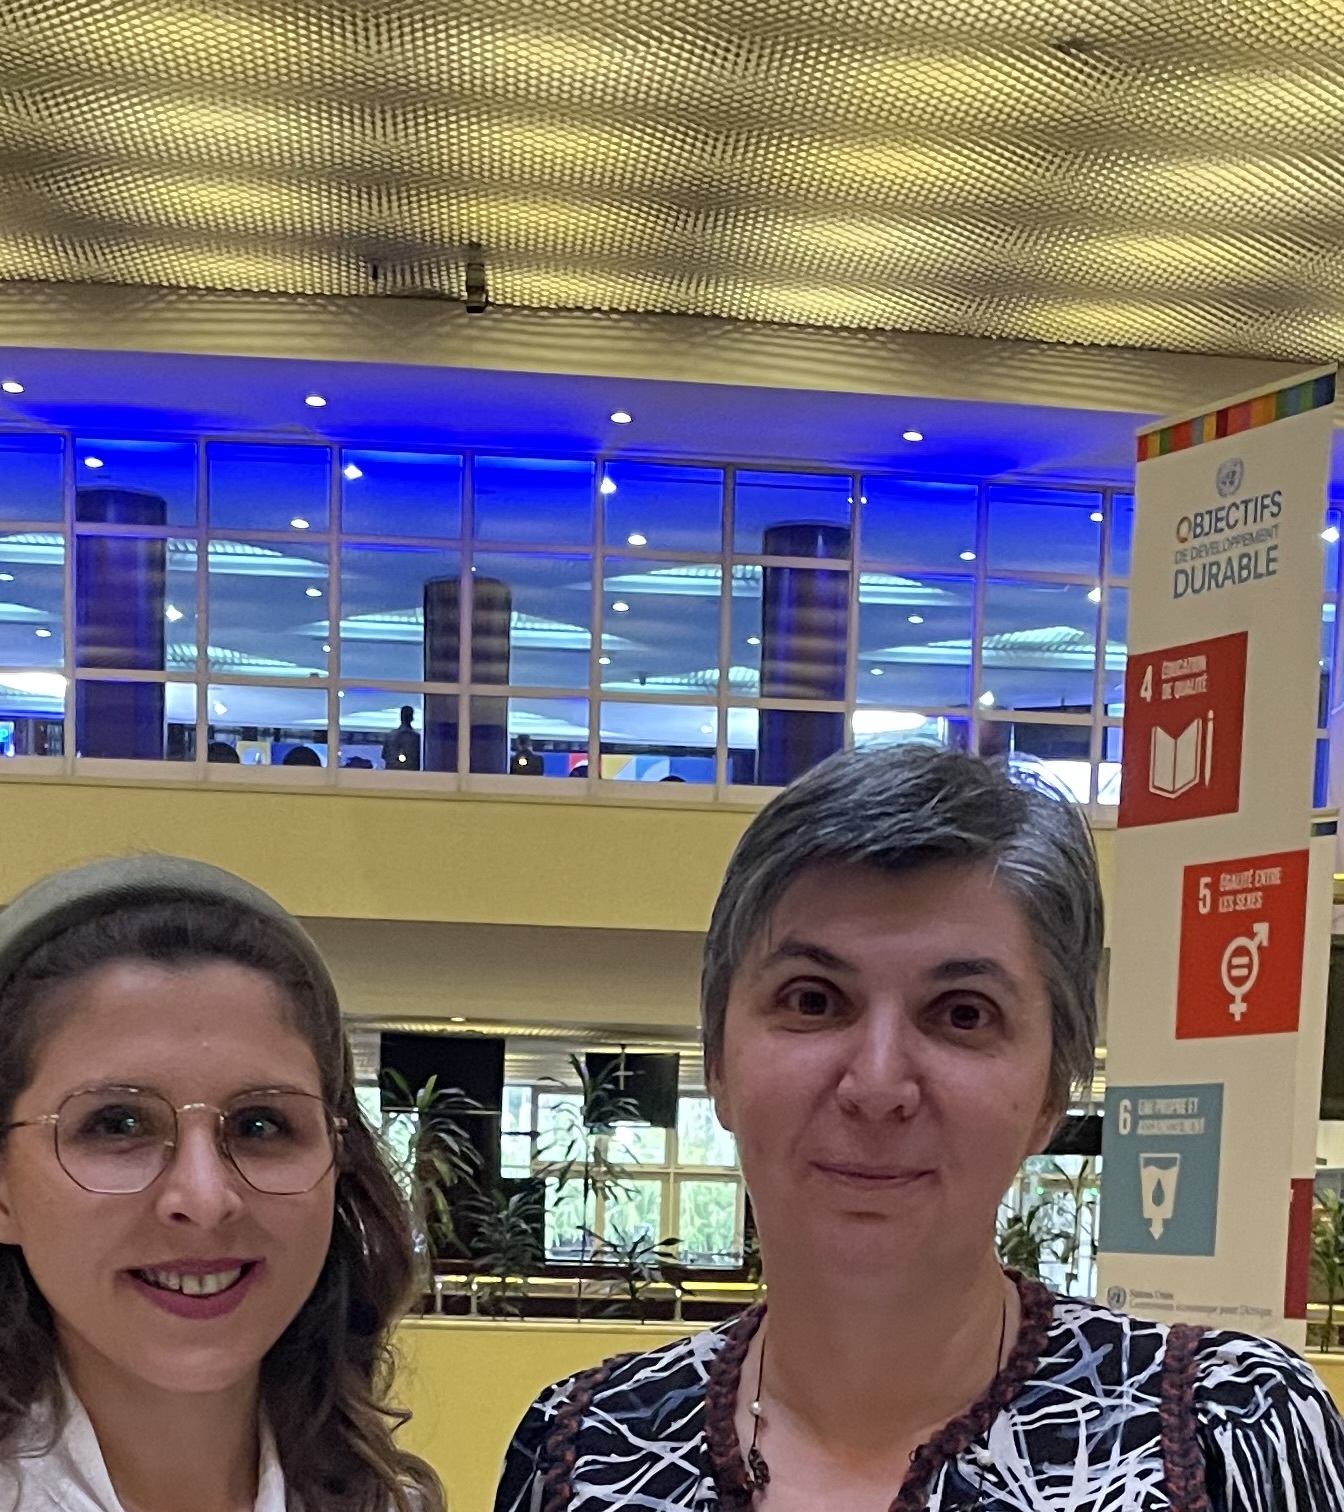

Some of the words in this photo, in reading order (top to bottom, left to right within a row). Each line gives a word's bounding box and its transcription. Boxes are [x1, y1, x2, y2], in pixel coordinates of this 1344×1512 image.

[1176, 490, 1283, 544] OBJECTIFS
[1173, 543, 1278, 599] DURABLE
[1140, 664, 1153, 702] 4
[1198, 876, 1212, 915] 5
[1119, 1099, 1132, 1135] 6
